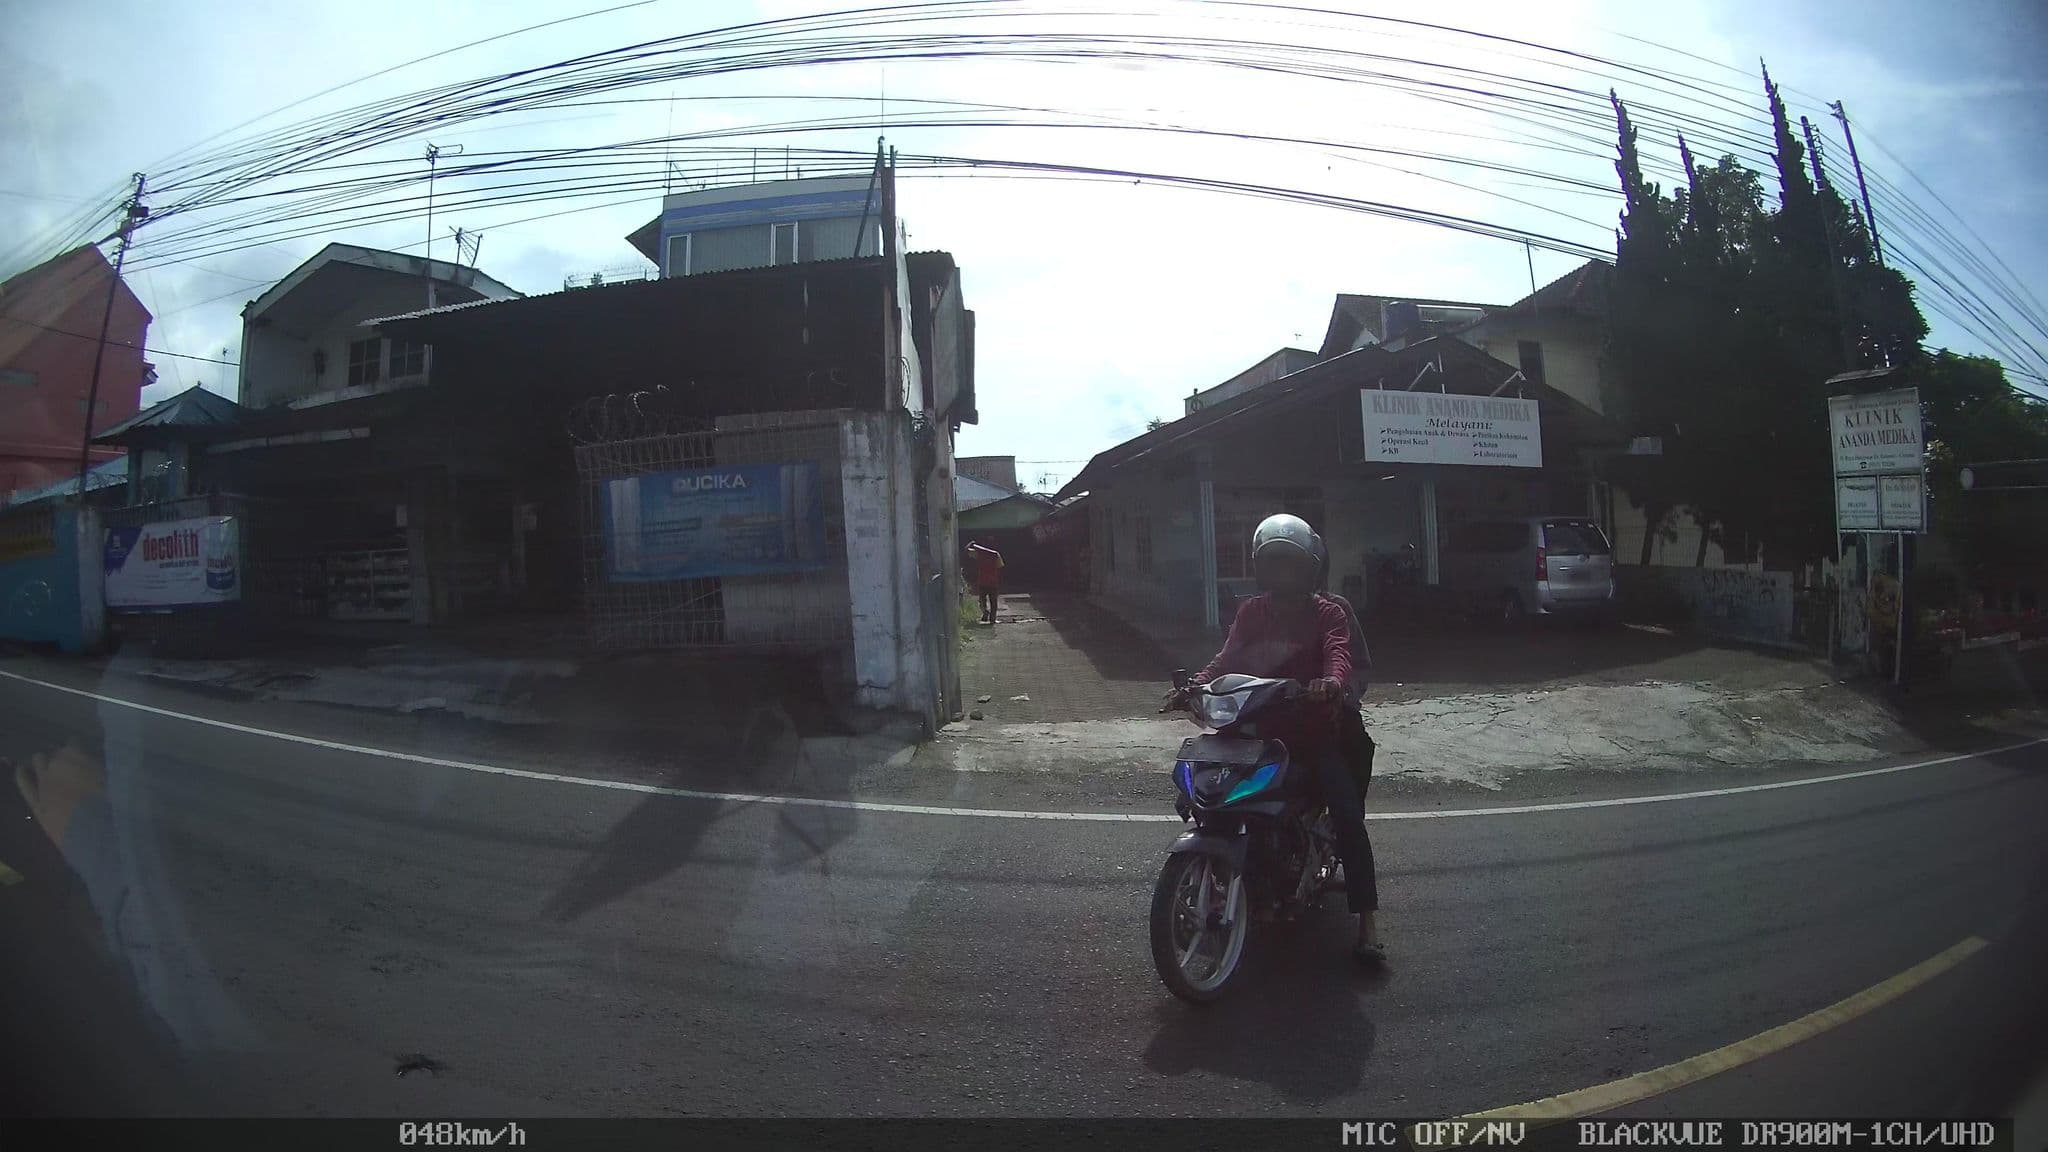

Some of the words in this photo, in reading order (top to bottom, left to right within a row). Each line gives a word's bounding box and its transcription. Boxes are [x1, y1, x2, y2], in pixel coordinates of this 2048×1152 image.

[1373, 394, 1422, 415] KLINIK
[1426, 397, 1479, 419] ANANDA
[1482, 400, 1531, 423] MEDIKA
[1845, 408, 1903, 428] KLINIK
[1840, 431, 1876, 449] ANANDA
[1877, 428, 1917, 445] MEDIKA
[1388, 447, 1399, 455] KB
[142, 529, 199, 561] decolith
